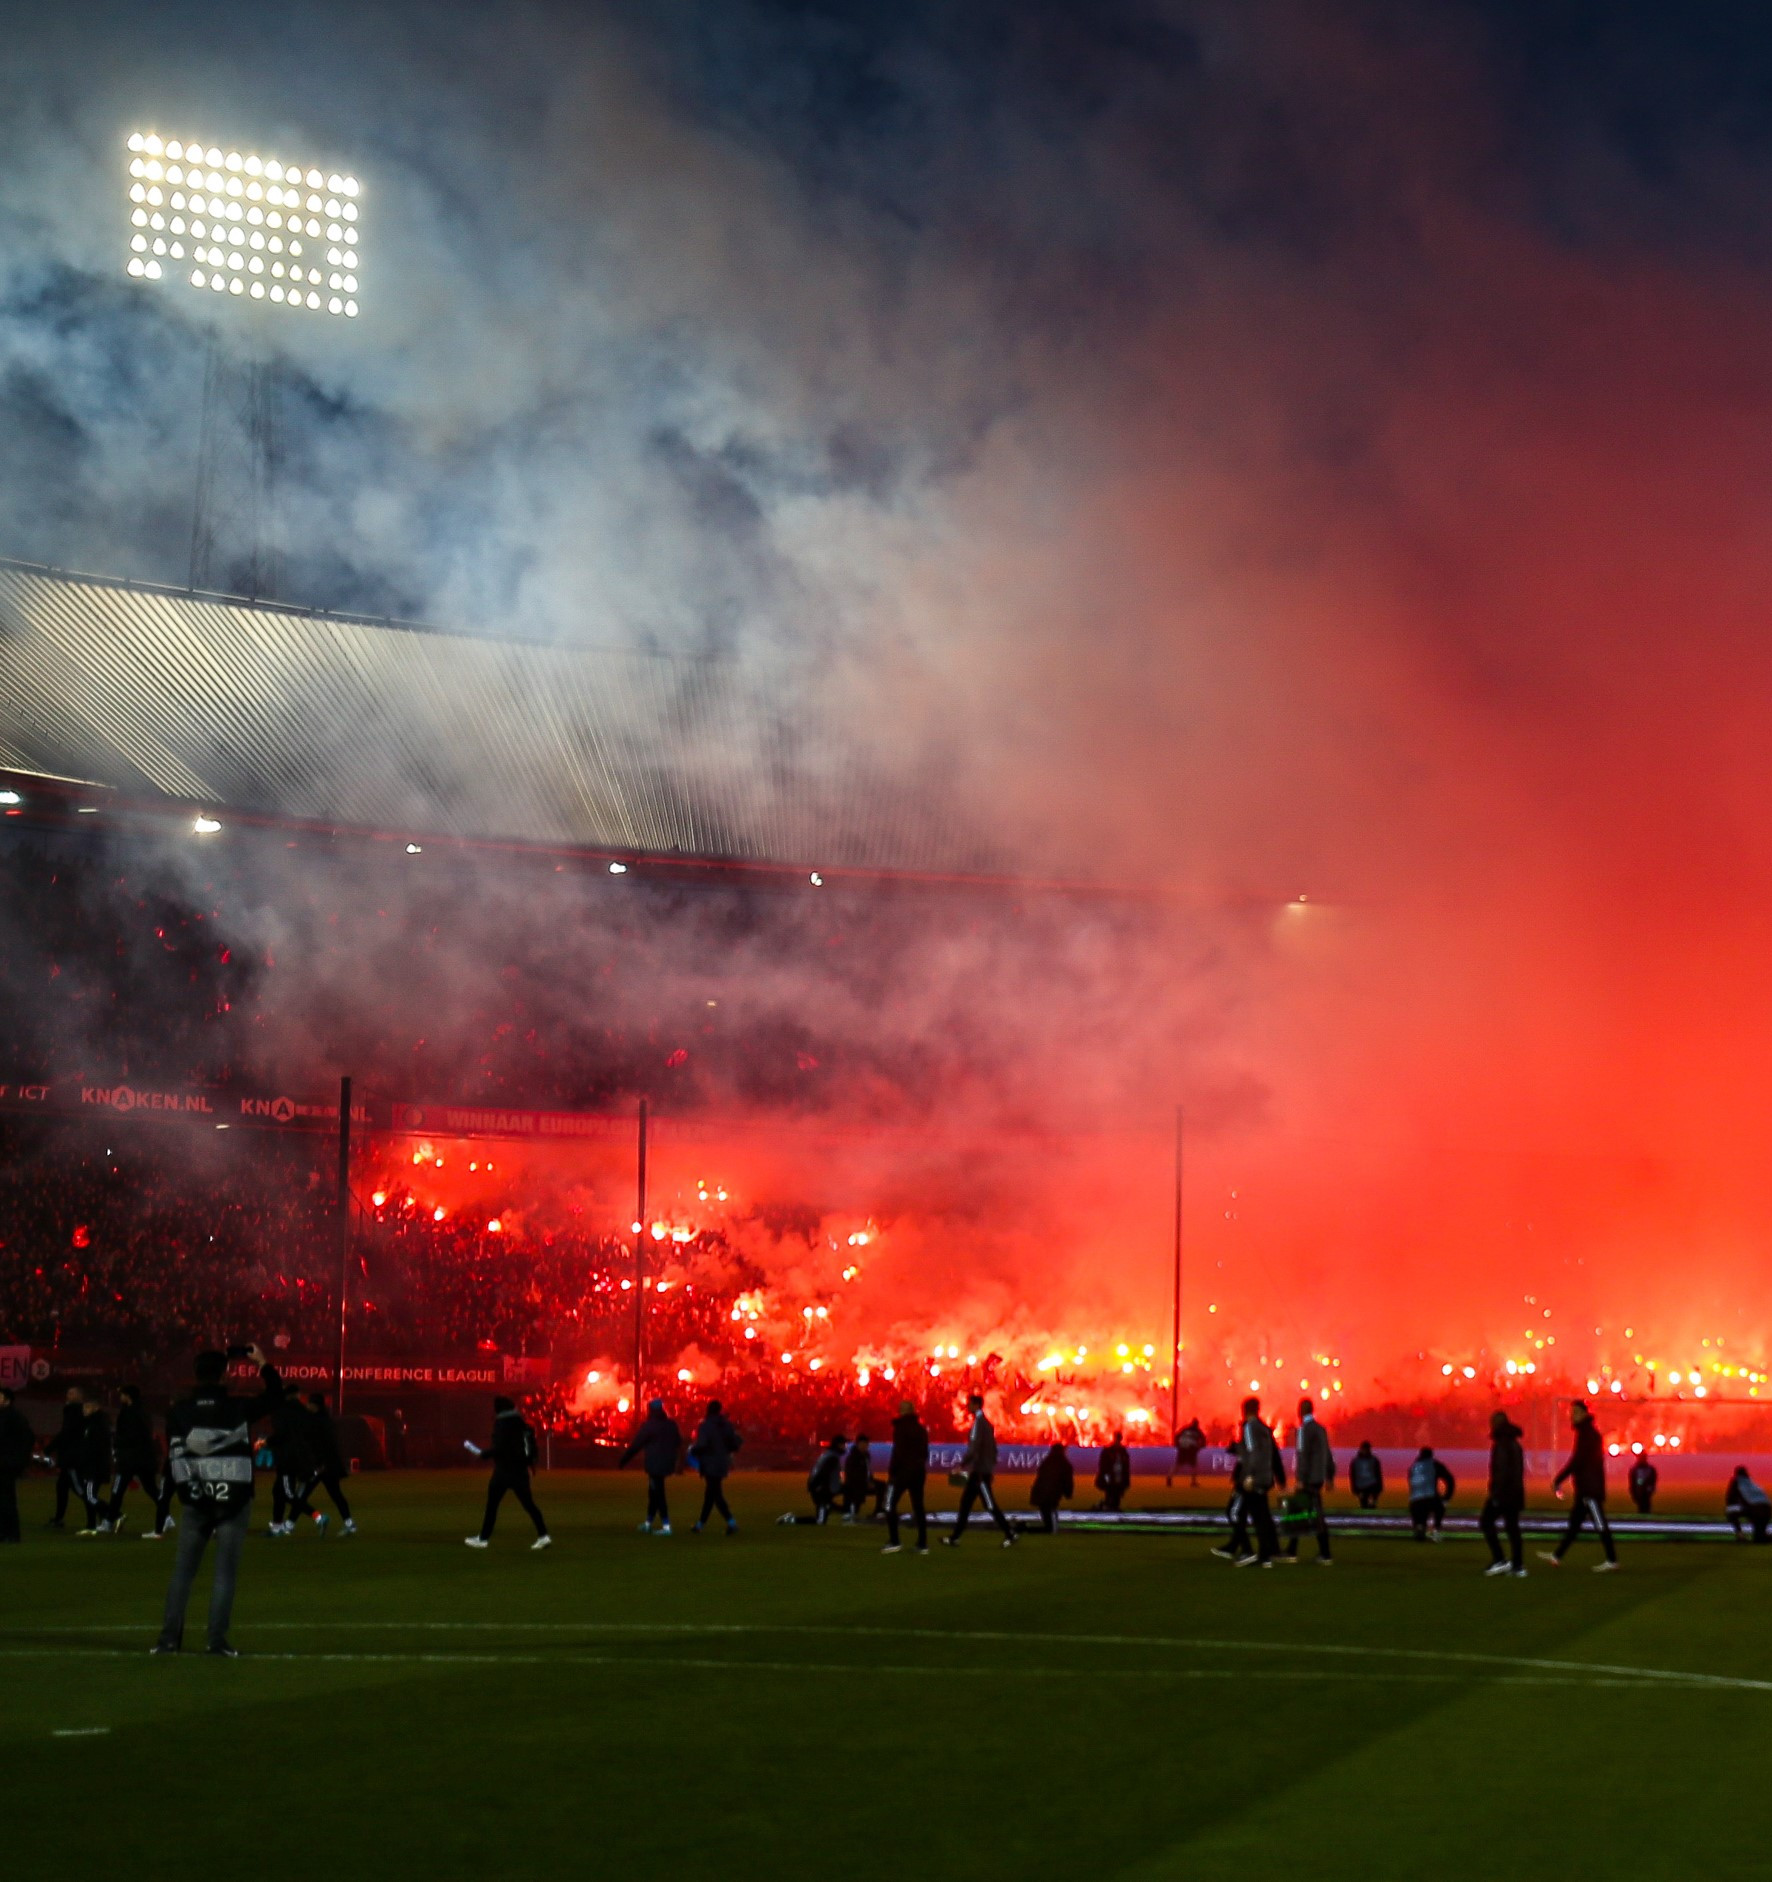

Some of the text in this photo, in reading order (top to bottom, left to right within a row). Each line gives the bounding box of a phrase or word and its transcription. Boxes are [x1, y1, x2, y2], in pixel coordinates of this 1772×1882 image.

[81, 1084, 214, 1113] KNAKEN.NL
[275, 1365, 328, 1379] UROPA
[332, 1366, 433, 1382] ONFERENCE
[438, 1369, 496, 1383] LEAGUE
